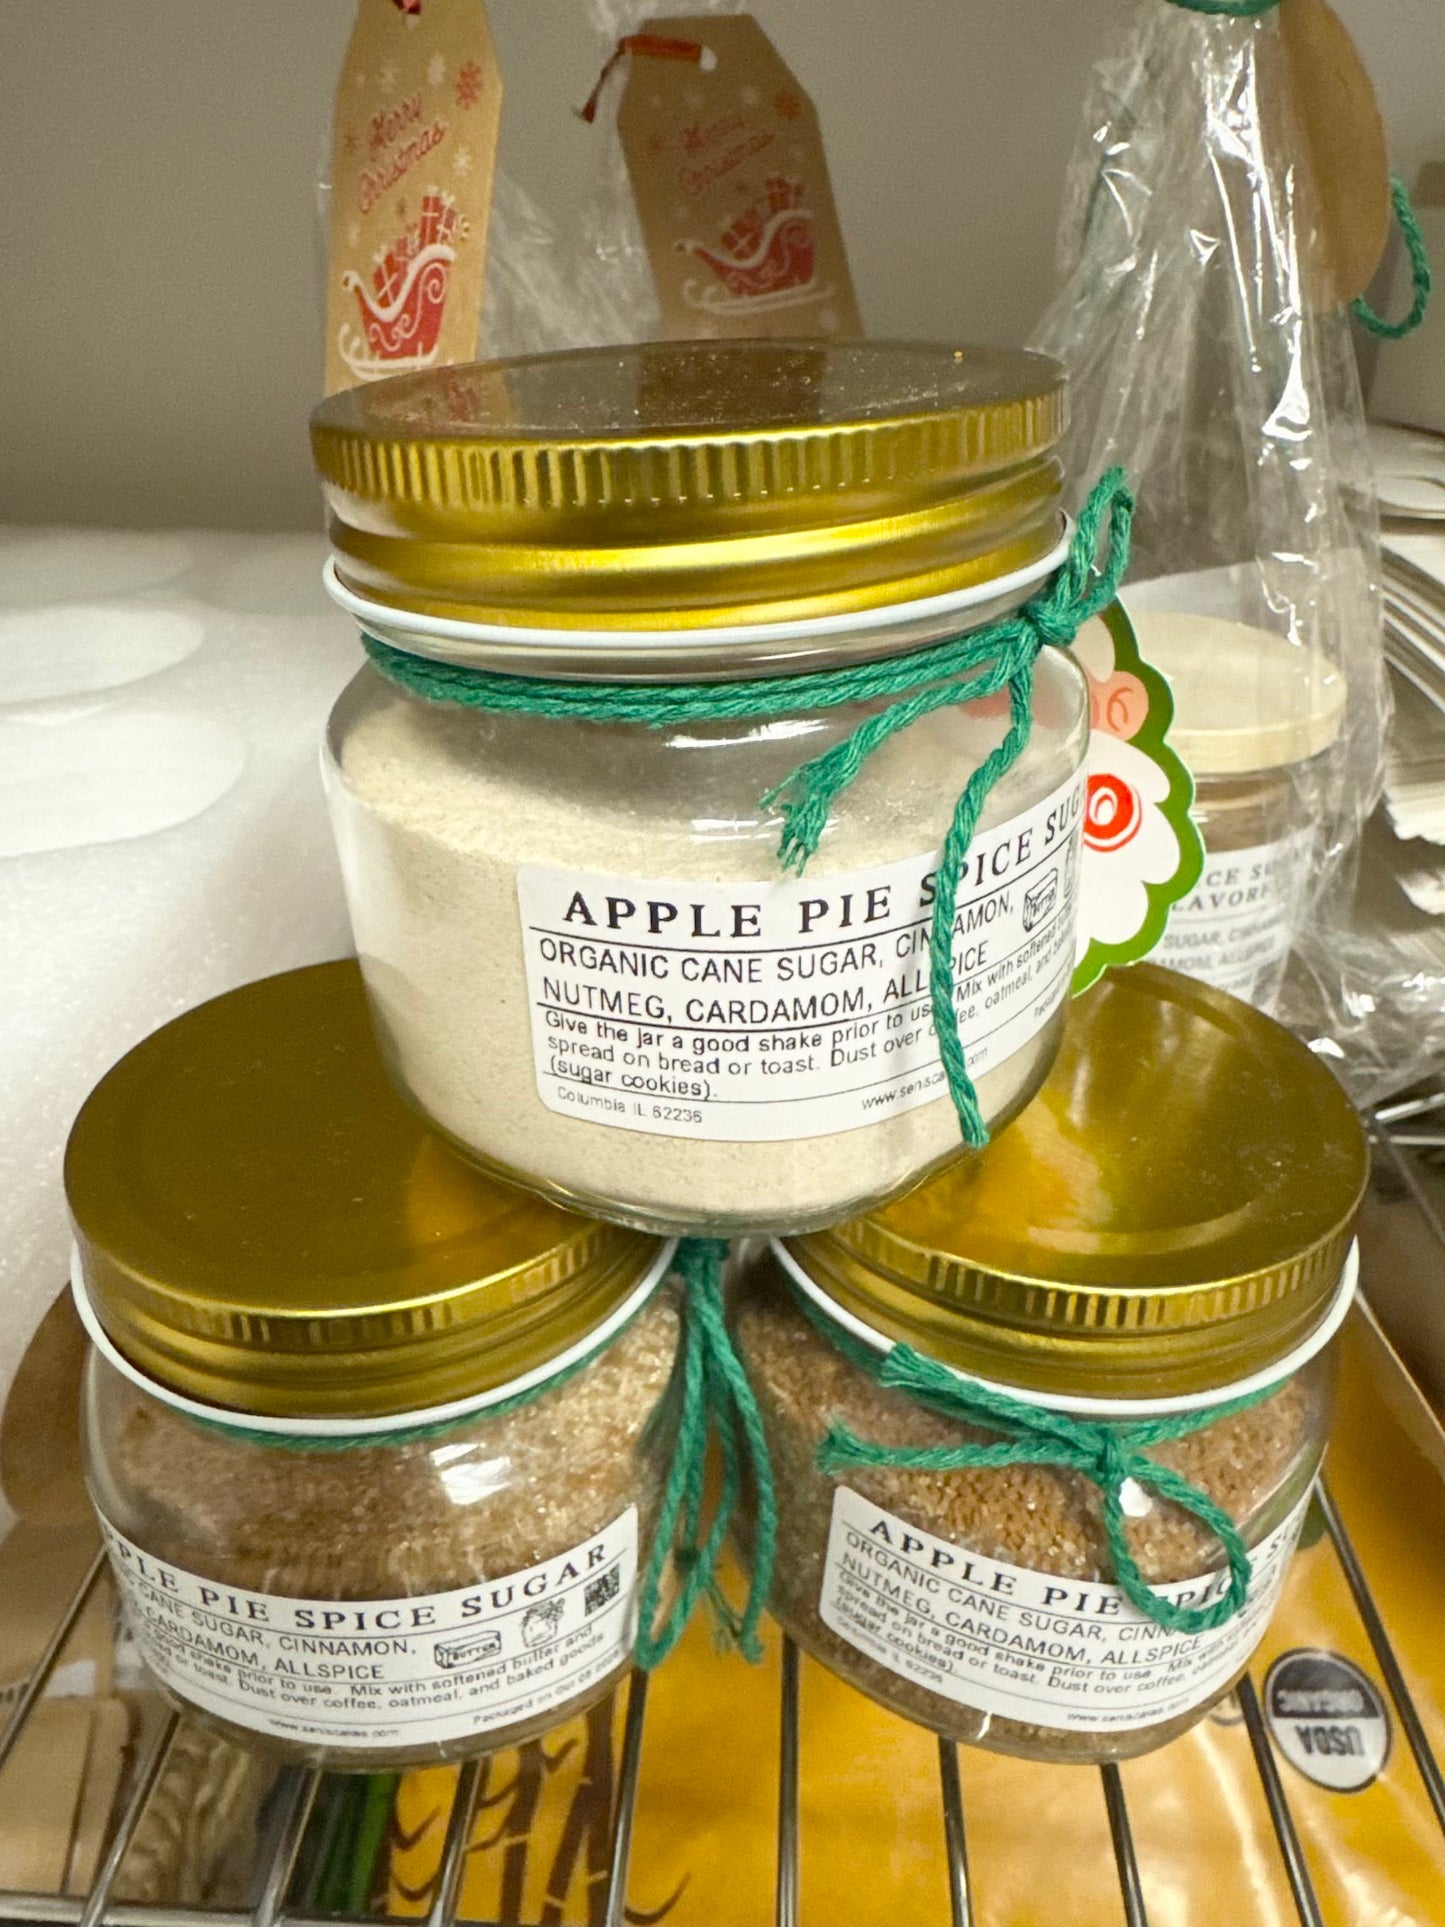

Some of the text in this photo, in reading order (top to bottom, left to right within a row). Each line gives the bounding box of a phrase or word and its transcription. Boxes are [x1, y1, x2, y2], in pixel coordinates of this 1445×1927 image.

[540, 938, 669, 979] ORGANIC
[681, 957, 763, 983] CANE
[777, 942, 884, 981] SUGAR,
[896, 891, 1014, 958] CINAMON,
[562, 891, 762, 937] APPLE
[798, 885, 892, 934] PIE
[543, 977, 673, 1024] NUTMEG,
[686, 986, 873, 1024] CARDAMOM,
[883, 940, 988, 1004] ALLICE
[546, 1010, 587, 1034] Give
[597, 1021, 628, 1042] the
[636, 1028, 664, 1048] jar
[672, 1036, 683, 1049] a
[692, 1036, 749, 1055] good
[759, 1033, 822, 1051] shake
[832, 1020, 879, 1047] prior
[886, 1010, 903, 1030] to
[956, 980, 983, 1003] Mix
[987, 957, 1014, 988] with
[548, 1035, 614, 1062] spread
[623, 1052, 650, 1068] on
[659, 1052, 720, 1074] bread
[728, 1060, 752, 1075] or
[761, 1054, 820, 1075] toast.
[830, 1041, 877, 1067] Dust
[884, 1028, 922, 1053] over
[551, 1055, 717, 1101] (sugar cookies).
[558, 1086, 626, 1113] Columbia
[652, 1106, 703, 1123] 62236
[199, 1586, 270, 1622] PIE
[294, 1606, 436, 1631] SPICE
[461, 1543, 605, 1618] SUGAR
[846, 1532, 942, 1594] ORGANIC
[948, 1588, 1011, 1620] CANE
[1018, 1611, 1107, 1642] SUGAR,
[869, 1520, 1018, 1596] APPLE
[1042, 1585, 1123, 1616] PIE
[191, 1610, 271, 1649] SUGAR,
[279, 1635, 416, 1656] CINNAMON,
[841, 1552, 1201, 1665] NUTMEG, CARDAMOM, ALLSPICE
[238, 1669, 273, 1685] prior
[280, 1678, 296, 1691] to
[351, 1685, 382, 1696] Mix
[389, 1681, 426, 1695] with
[432, 1663, 507, 1690] softened
[512, 1643, 560, 1670] butter
[565, 1625, 592, 1648] and
[274, 1657, 385, 1680] ALLSPICE
[891, 1621, 912, 1637] on
[917, 1632, 964, 1660] bread
[968, 1656, 988, 1669] or
[1048, 1676, 1088, 1693] Dust
[1094, 1684, 1131, 1694] over
[904, 1611, 924, 1626] jar
[931, 1626, 940, 1637] a
[945, 1633, 989, 1656] good
[995, 1648, 1046, 1672] shake
[1052, 1664, 1093, 1679] prior
[1101, 1669, 1116, 1681] to
[1123, 1669, 1151, 1680] use
[281, 1692, 316, 1706] over
[469, 1679, 500, 1696] and
[507, 1660, 554, 1685] baked
[1295, 1725, 1366, 1757] USDA
